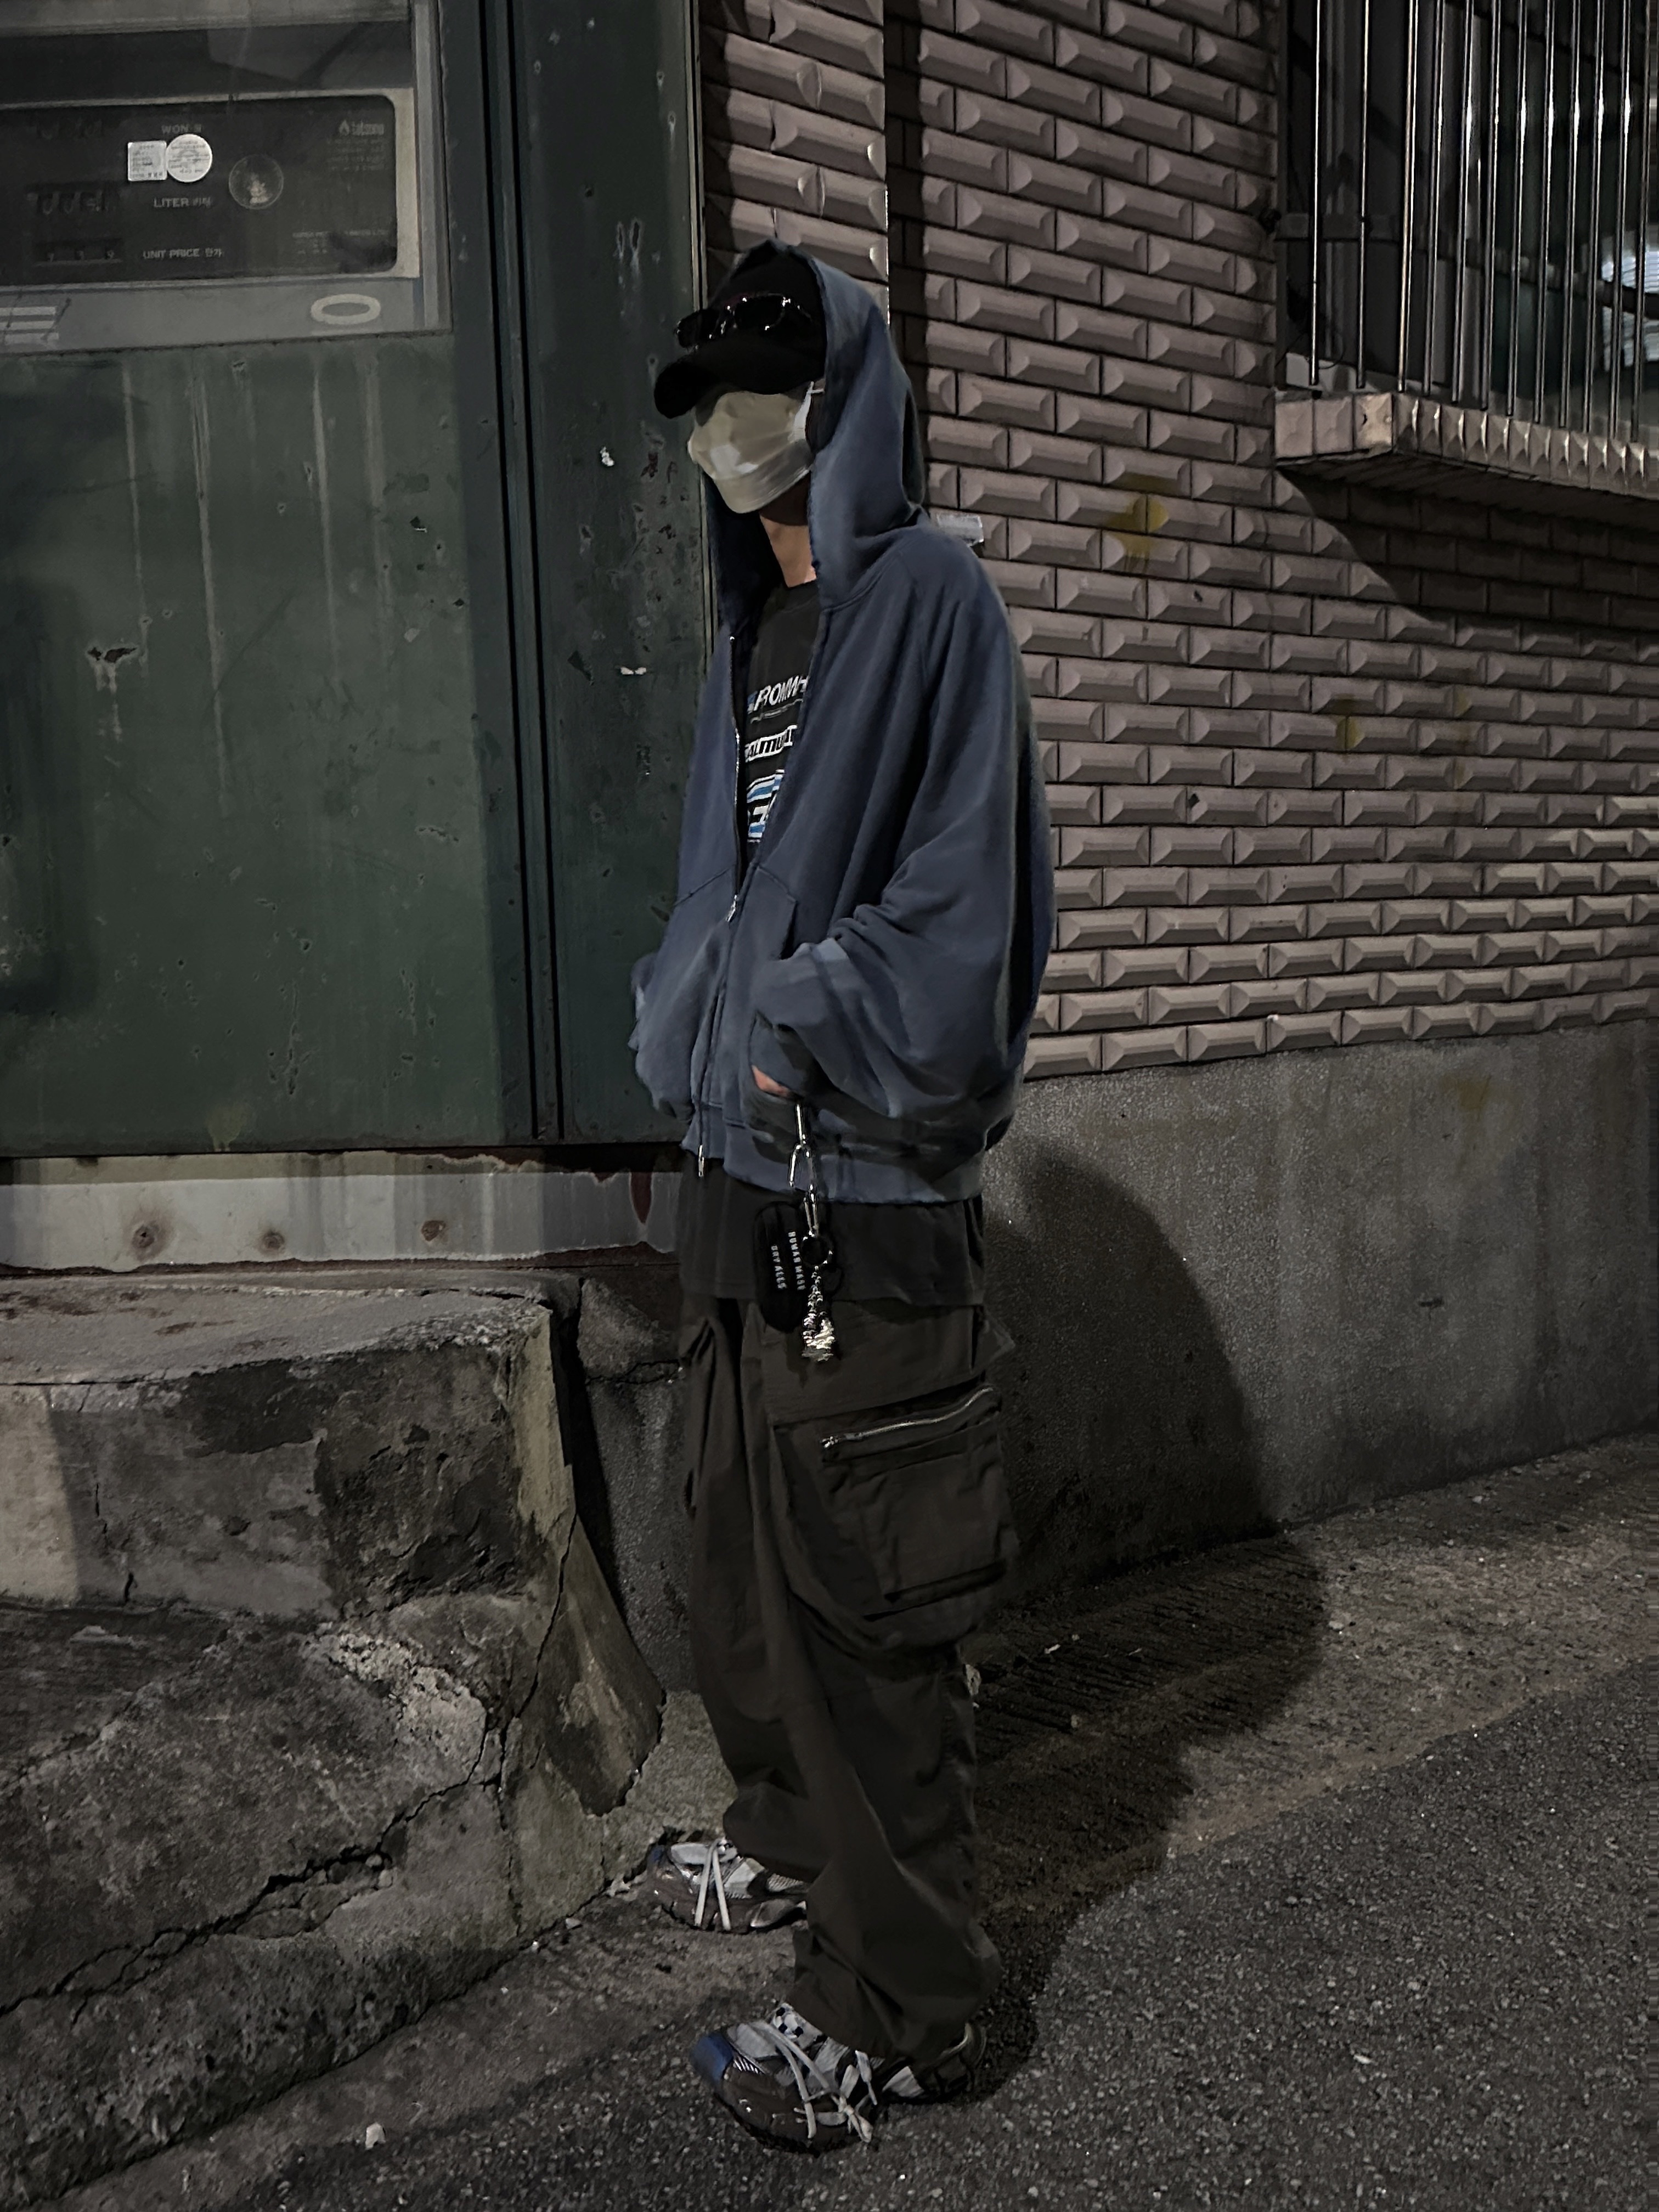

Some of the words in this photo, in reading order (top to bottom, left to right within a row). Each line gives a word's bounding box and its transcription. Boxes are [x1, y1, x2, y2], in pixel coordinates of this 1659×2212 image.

[161, 124, 189, 133] WON
[154, 198, 189, 208] LITER
[143, 250, 166, 259] UNIT
[169, 248, 200, 258] PRICE
